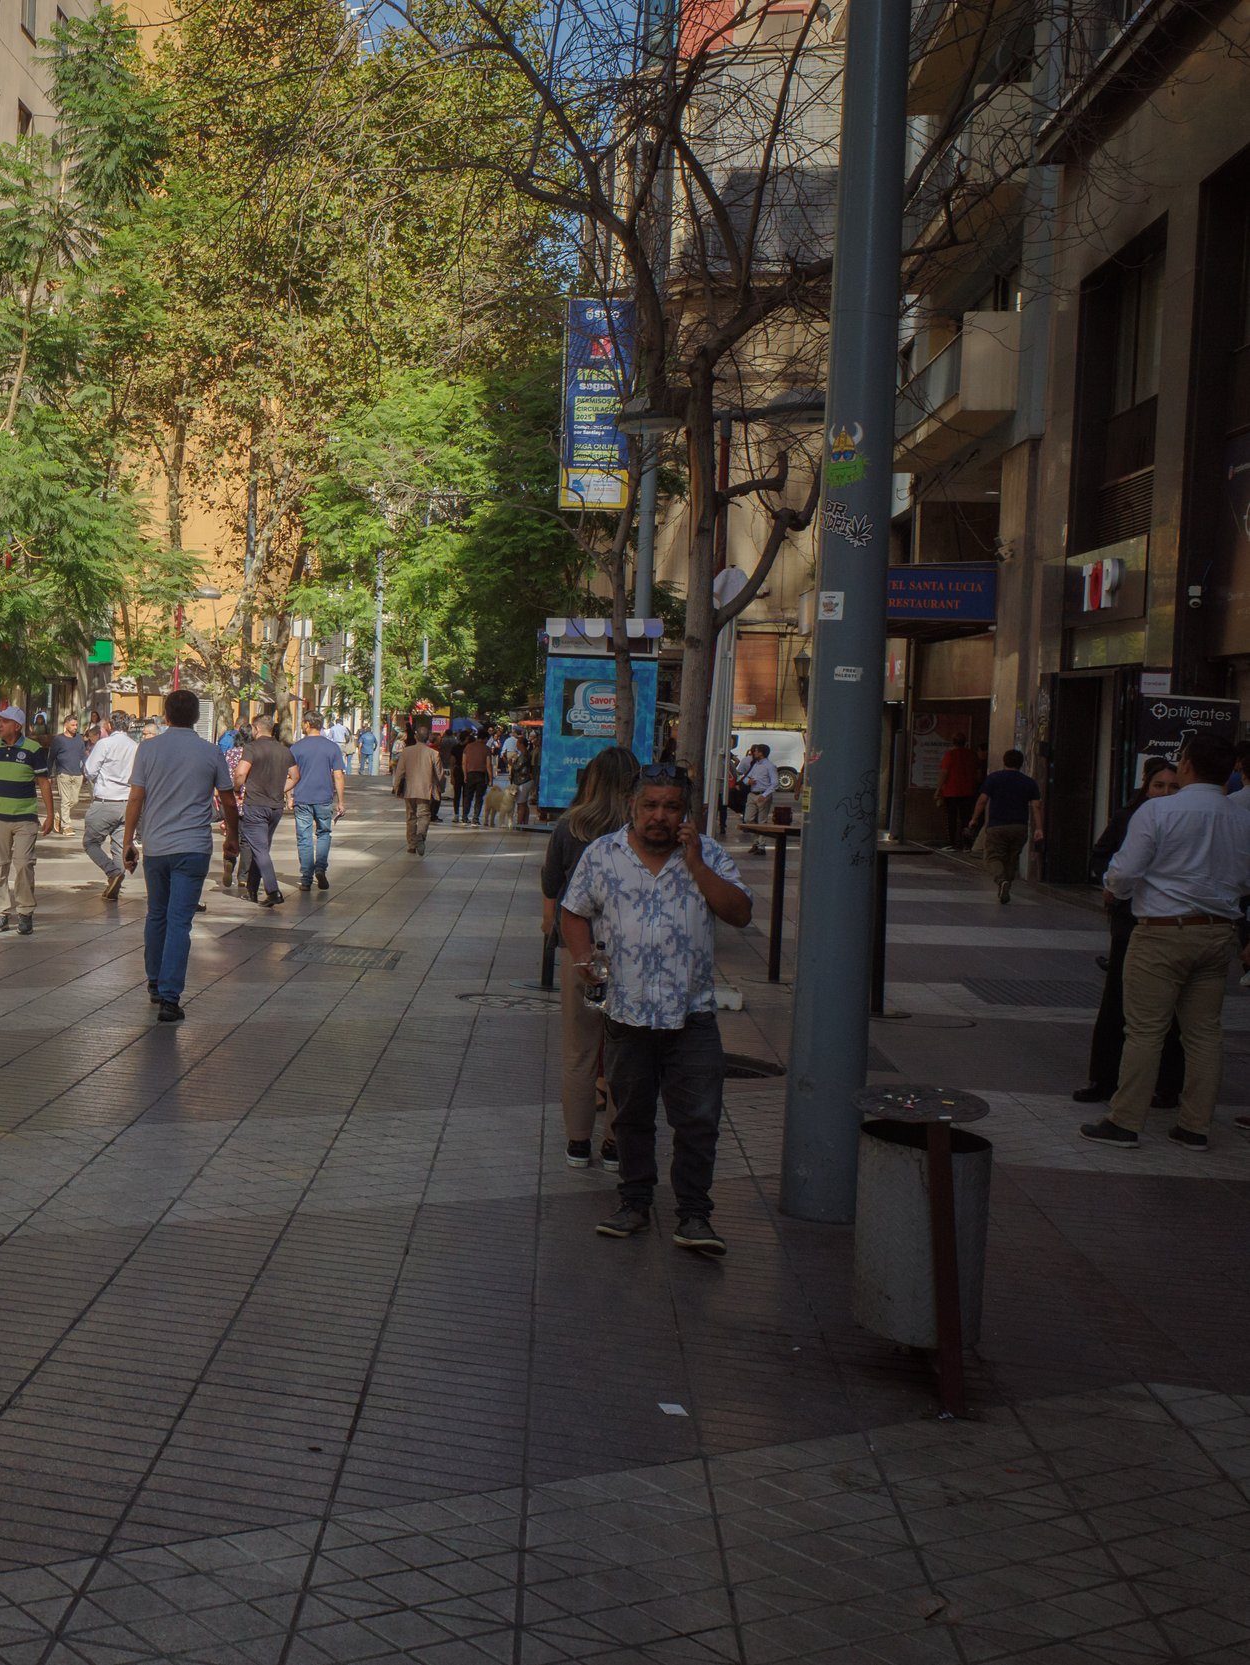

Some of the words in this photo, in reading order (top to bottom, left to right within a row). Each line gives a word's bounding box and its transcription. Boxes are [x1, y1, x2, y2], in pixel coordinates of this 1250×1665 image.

[909, 580, 945, 592] SANTA
[1082, 558, 1120, 613] TOP
[886, 598, 960, 610] RESTAURANT
[570, 710, 591, 722] 65
[1150, 701, 1232, 721] Optilentes
